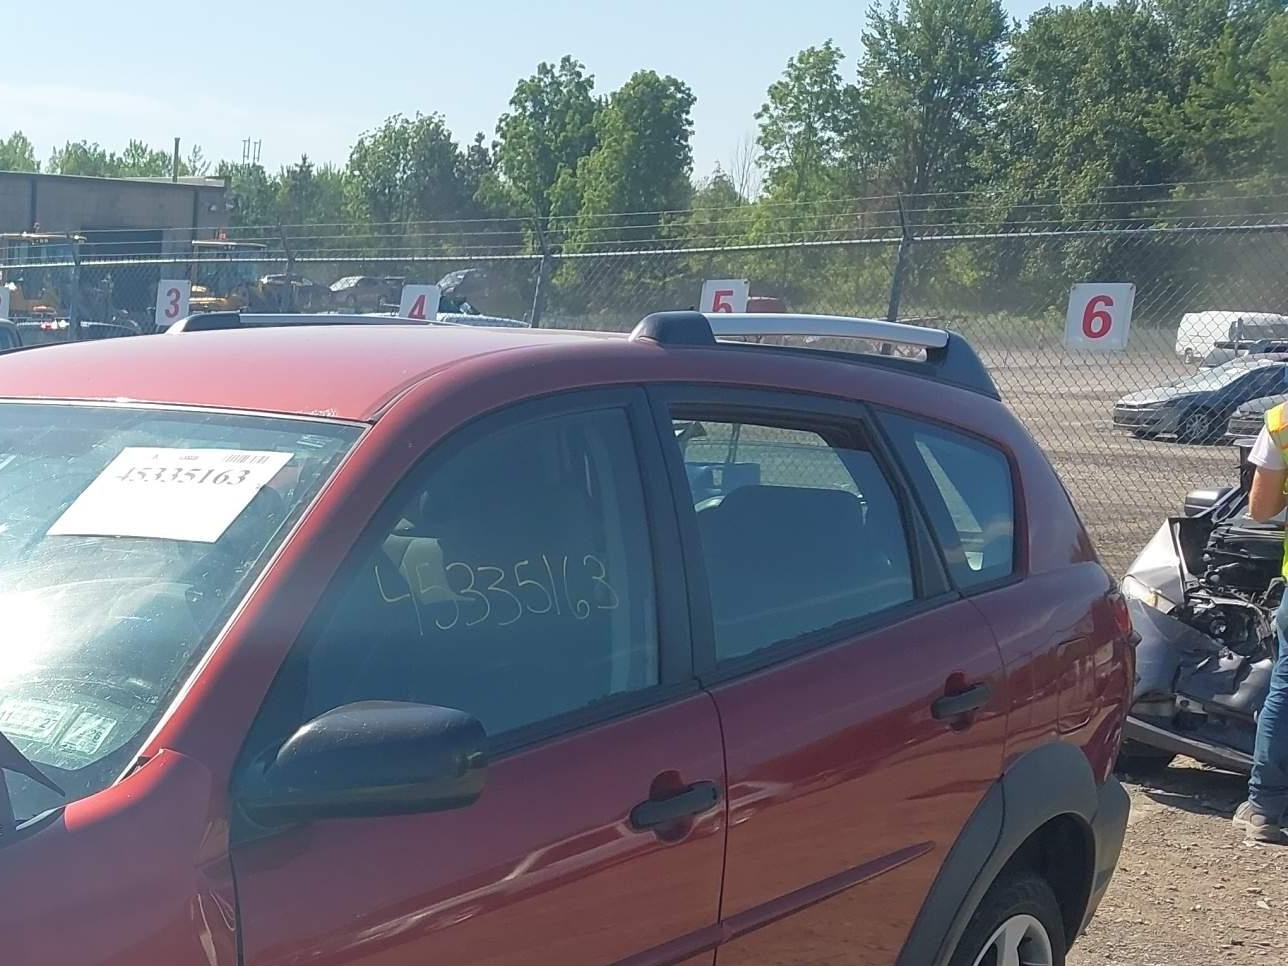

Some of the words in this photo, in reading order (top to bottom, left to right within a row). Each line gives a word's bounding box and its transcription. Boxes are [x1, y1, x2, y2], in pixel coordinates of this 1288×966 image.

[164, 288, 181, 318] 3
[409, 294, 427, 319] 4
[712, 289, 734, 313] 5
[1081, 295, 1114, 339] 6
[375, 553, 620, 636] 45335163
